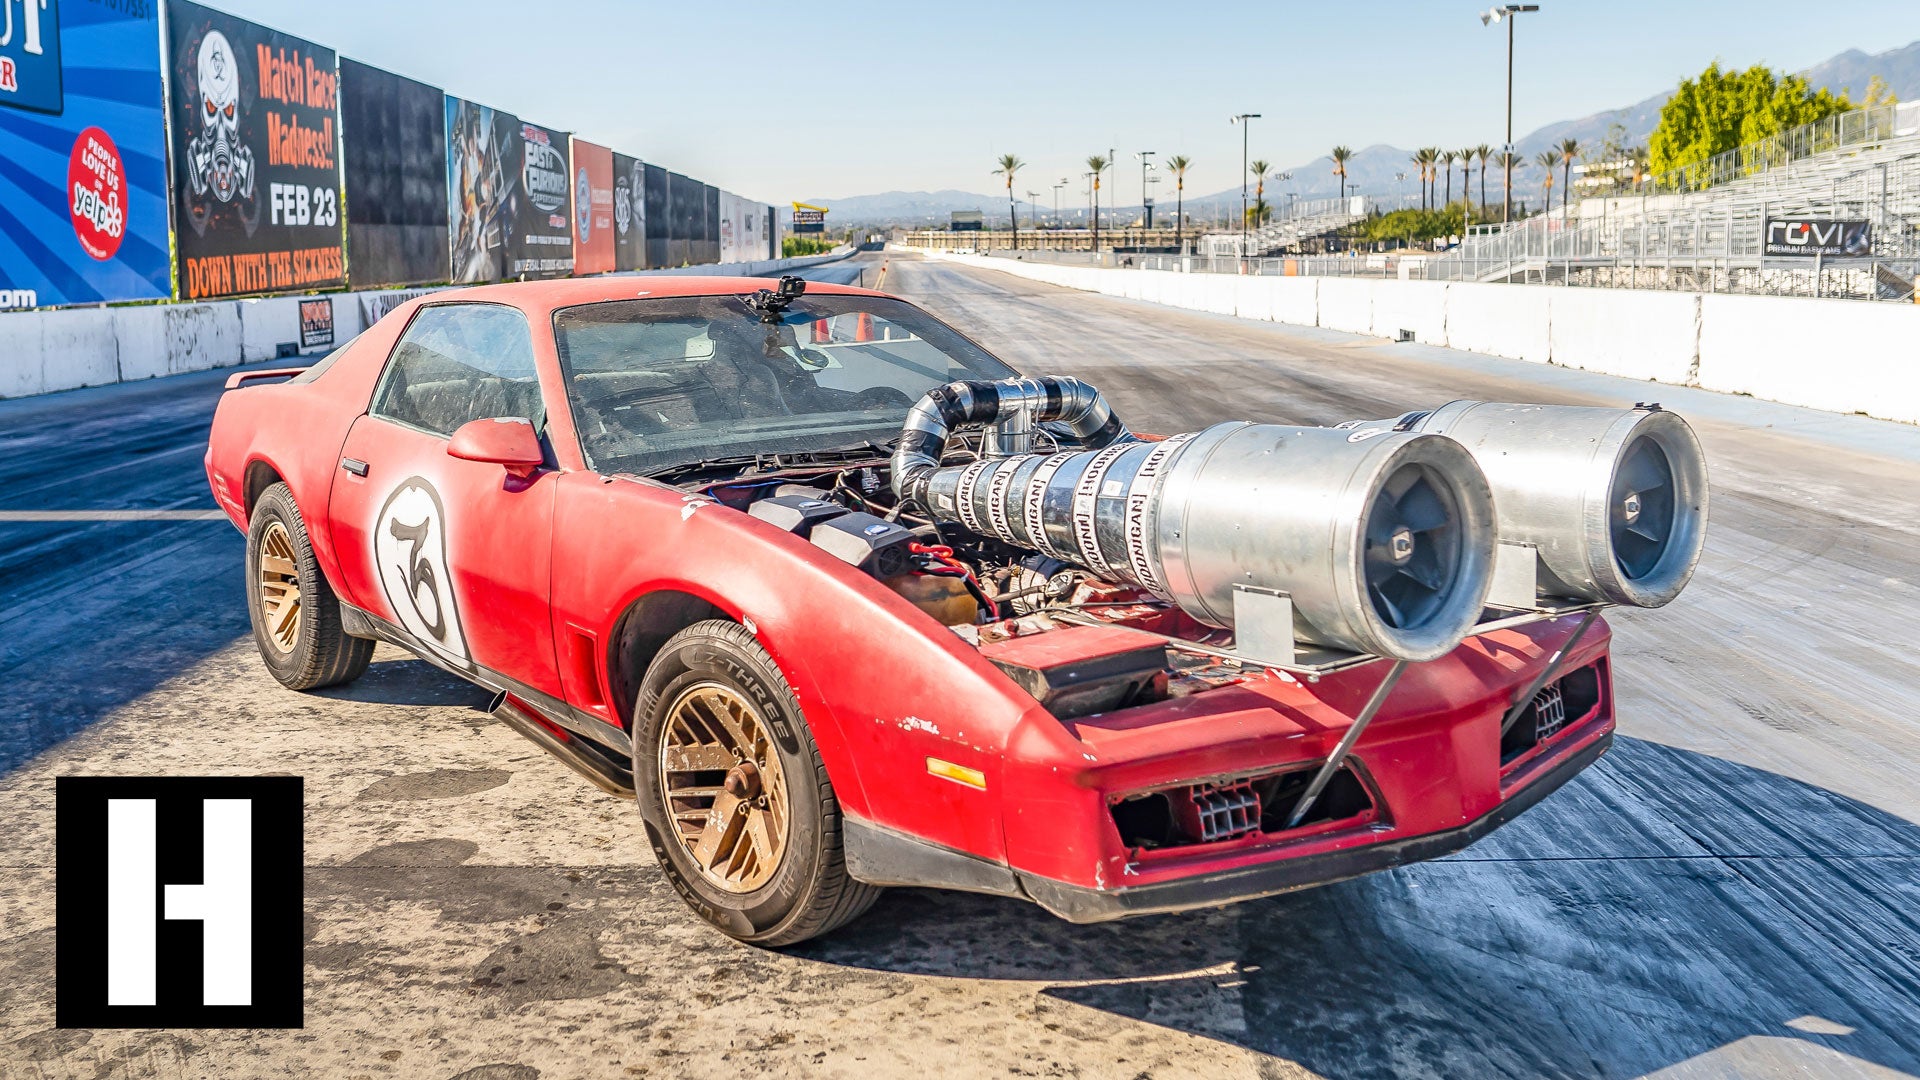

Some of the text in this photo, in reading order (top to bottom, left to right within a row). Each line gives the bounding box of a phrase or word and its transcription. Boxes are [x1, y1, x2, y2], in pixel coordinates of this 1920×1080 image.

[257, 43, 336, 110] Match Race
[88, 136, 117, 171] PEOPLE
[267, 111, 334, 169] Madness!!
[82, 147, 119, 191] LOVE US
[75, 184, 107, 228] yelp
[270, 182, 337, 227] FEB 23
[1767, 245, 1800, 255] PREMIUM
[187, 246, 342, 299] DOWN WITH THE SICKNESS
